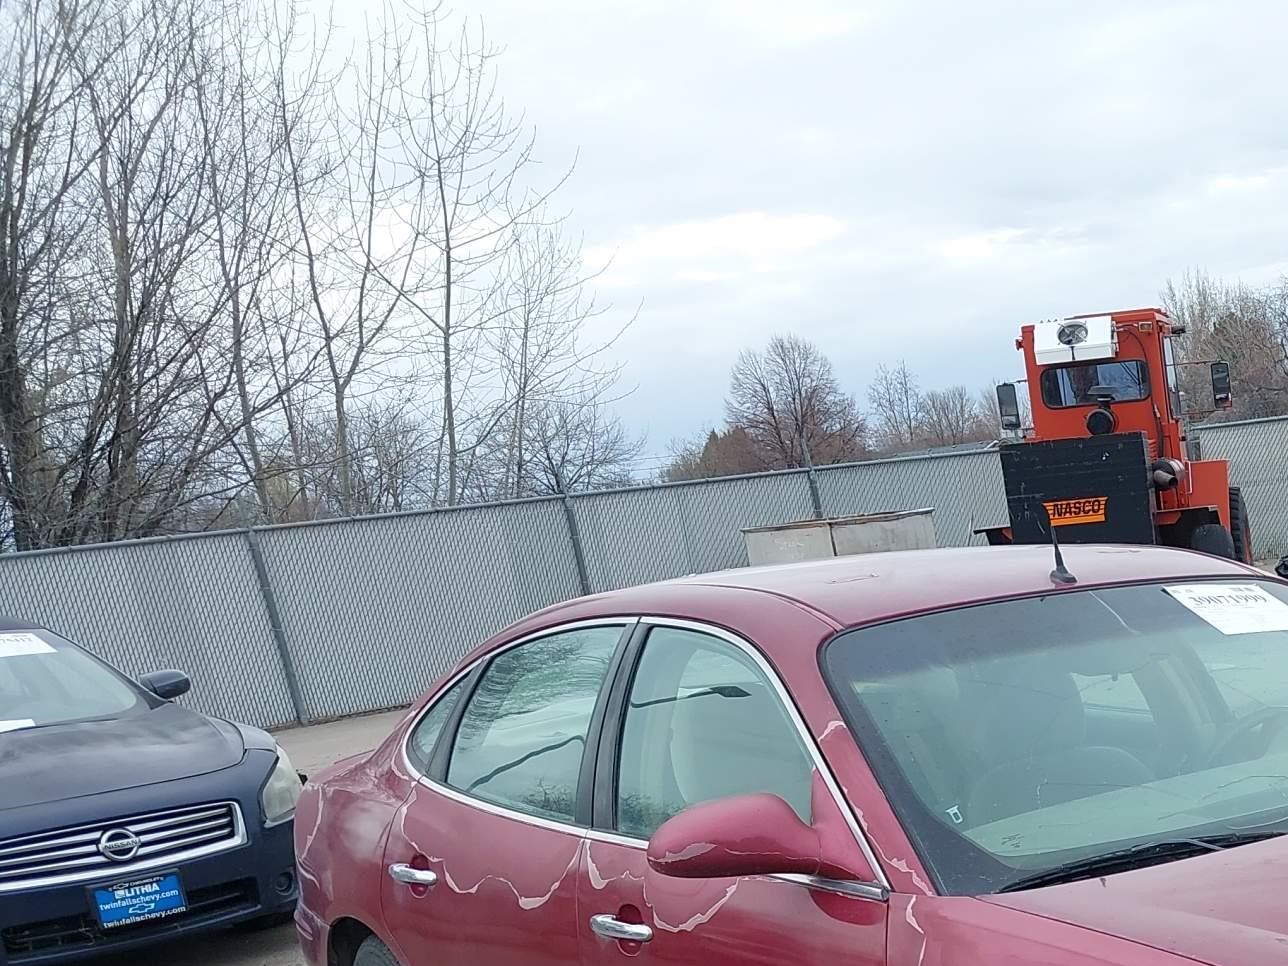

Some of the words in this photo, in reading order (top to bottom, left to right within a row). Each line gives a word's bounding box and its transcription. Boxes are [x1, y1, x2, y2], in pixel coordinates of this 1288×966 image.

[1052, 500, 1101, 517] NASCO
[103, 838, 138, 850] NISSAN
[125, 882, 160, 897] LITHIA
[100, 889, 179, 911] twinfallschevy.com
[103, 906, 187, 929] twinfallschevy.com
